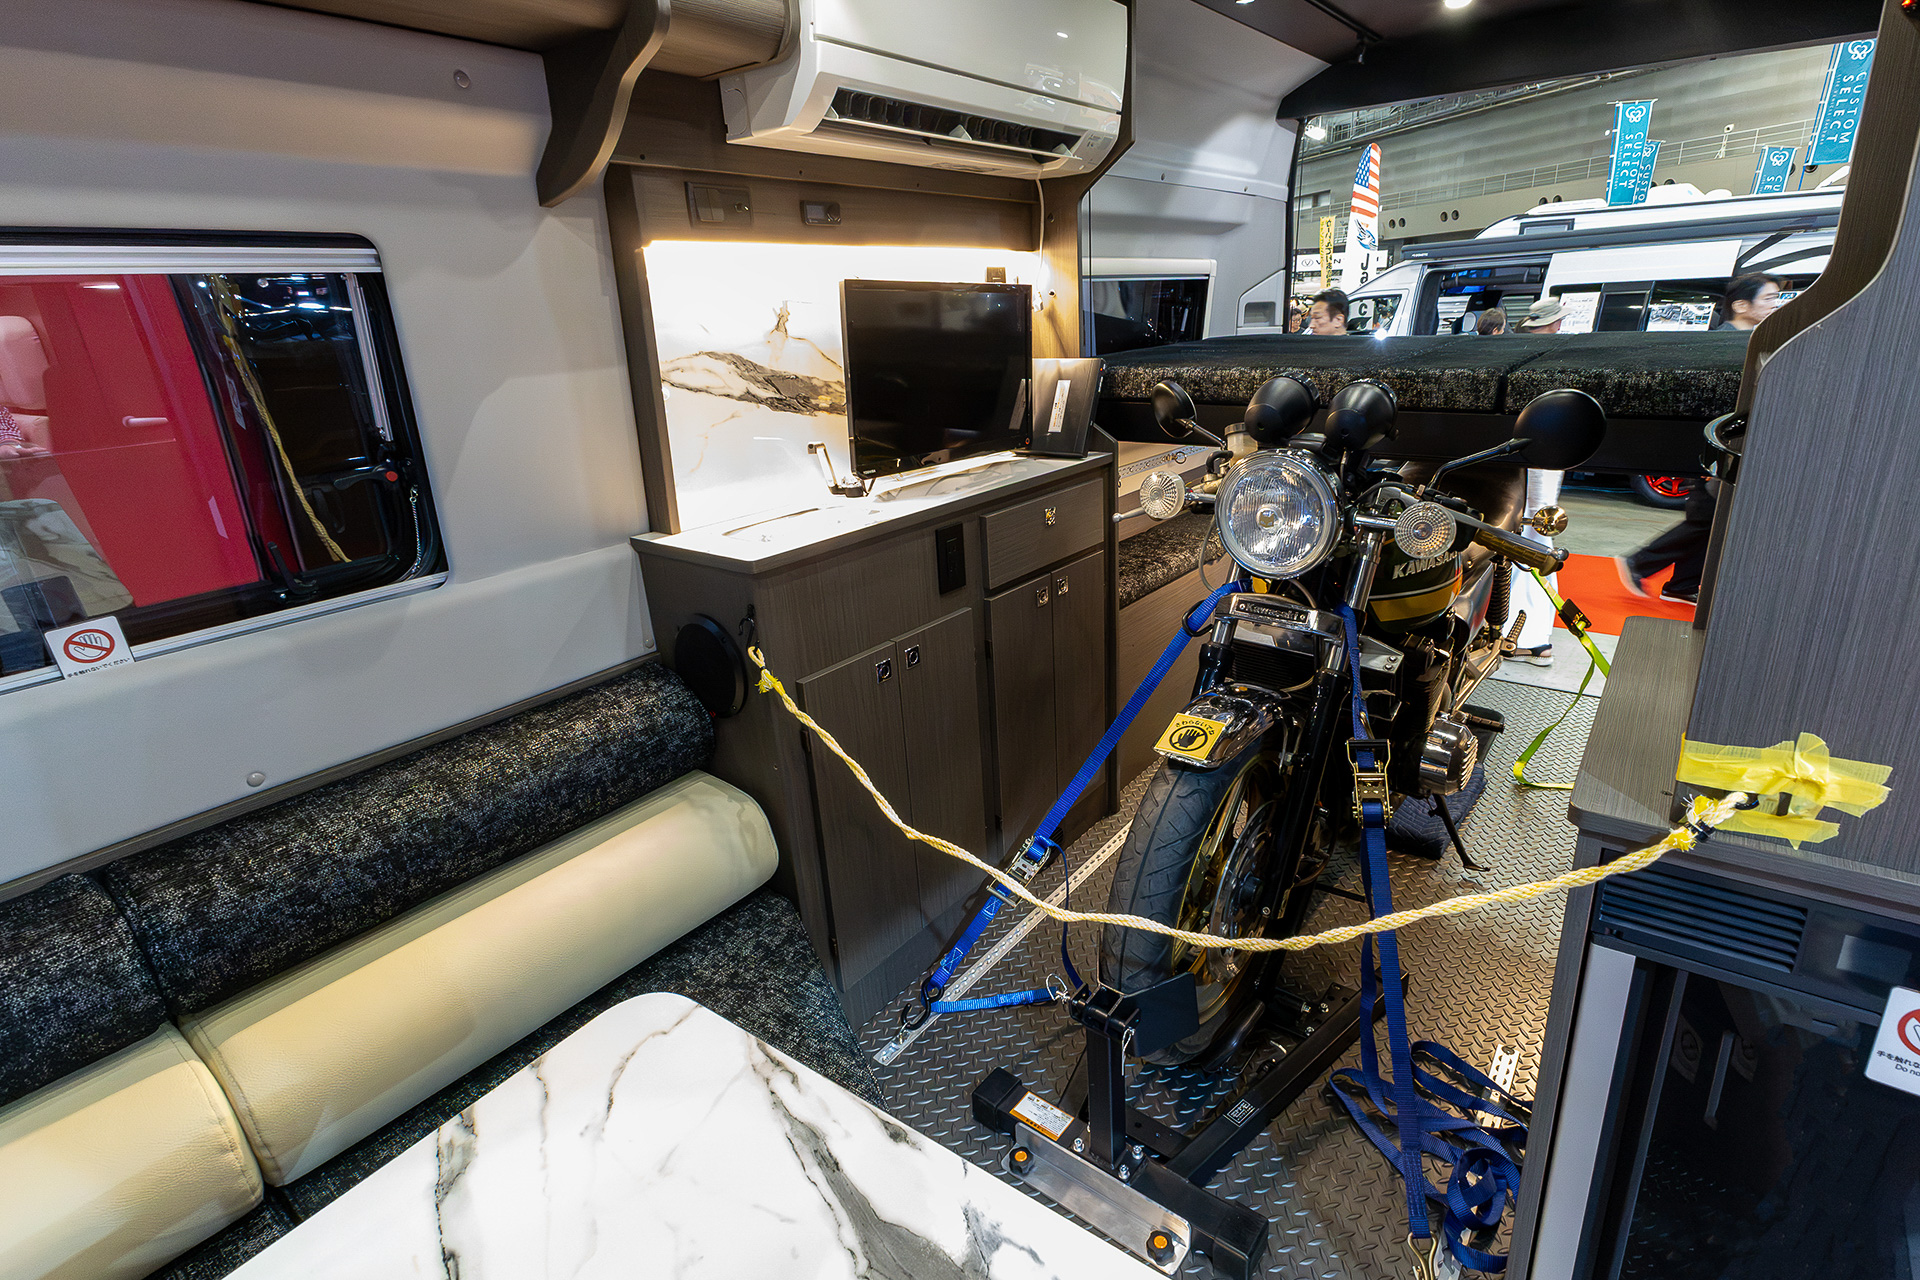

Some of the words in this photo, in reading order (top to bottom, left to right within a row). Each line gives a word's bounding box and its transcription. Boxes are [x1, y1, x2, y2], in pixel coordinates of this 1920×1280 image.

[1826, 75, 1855, 143] SELECT
[1838, 71, 1868, 144] CUSTOM
[1618, 134, 1634, 187] SELECT
[1628, 131, 1644, 189] CUSTOM
[1894, 1063, 1909, 1073] Do
